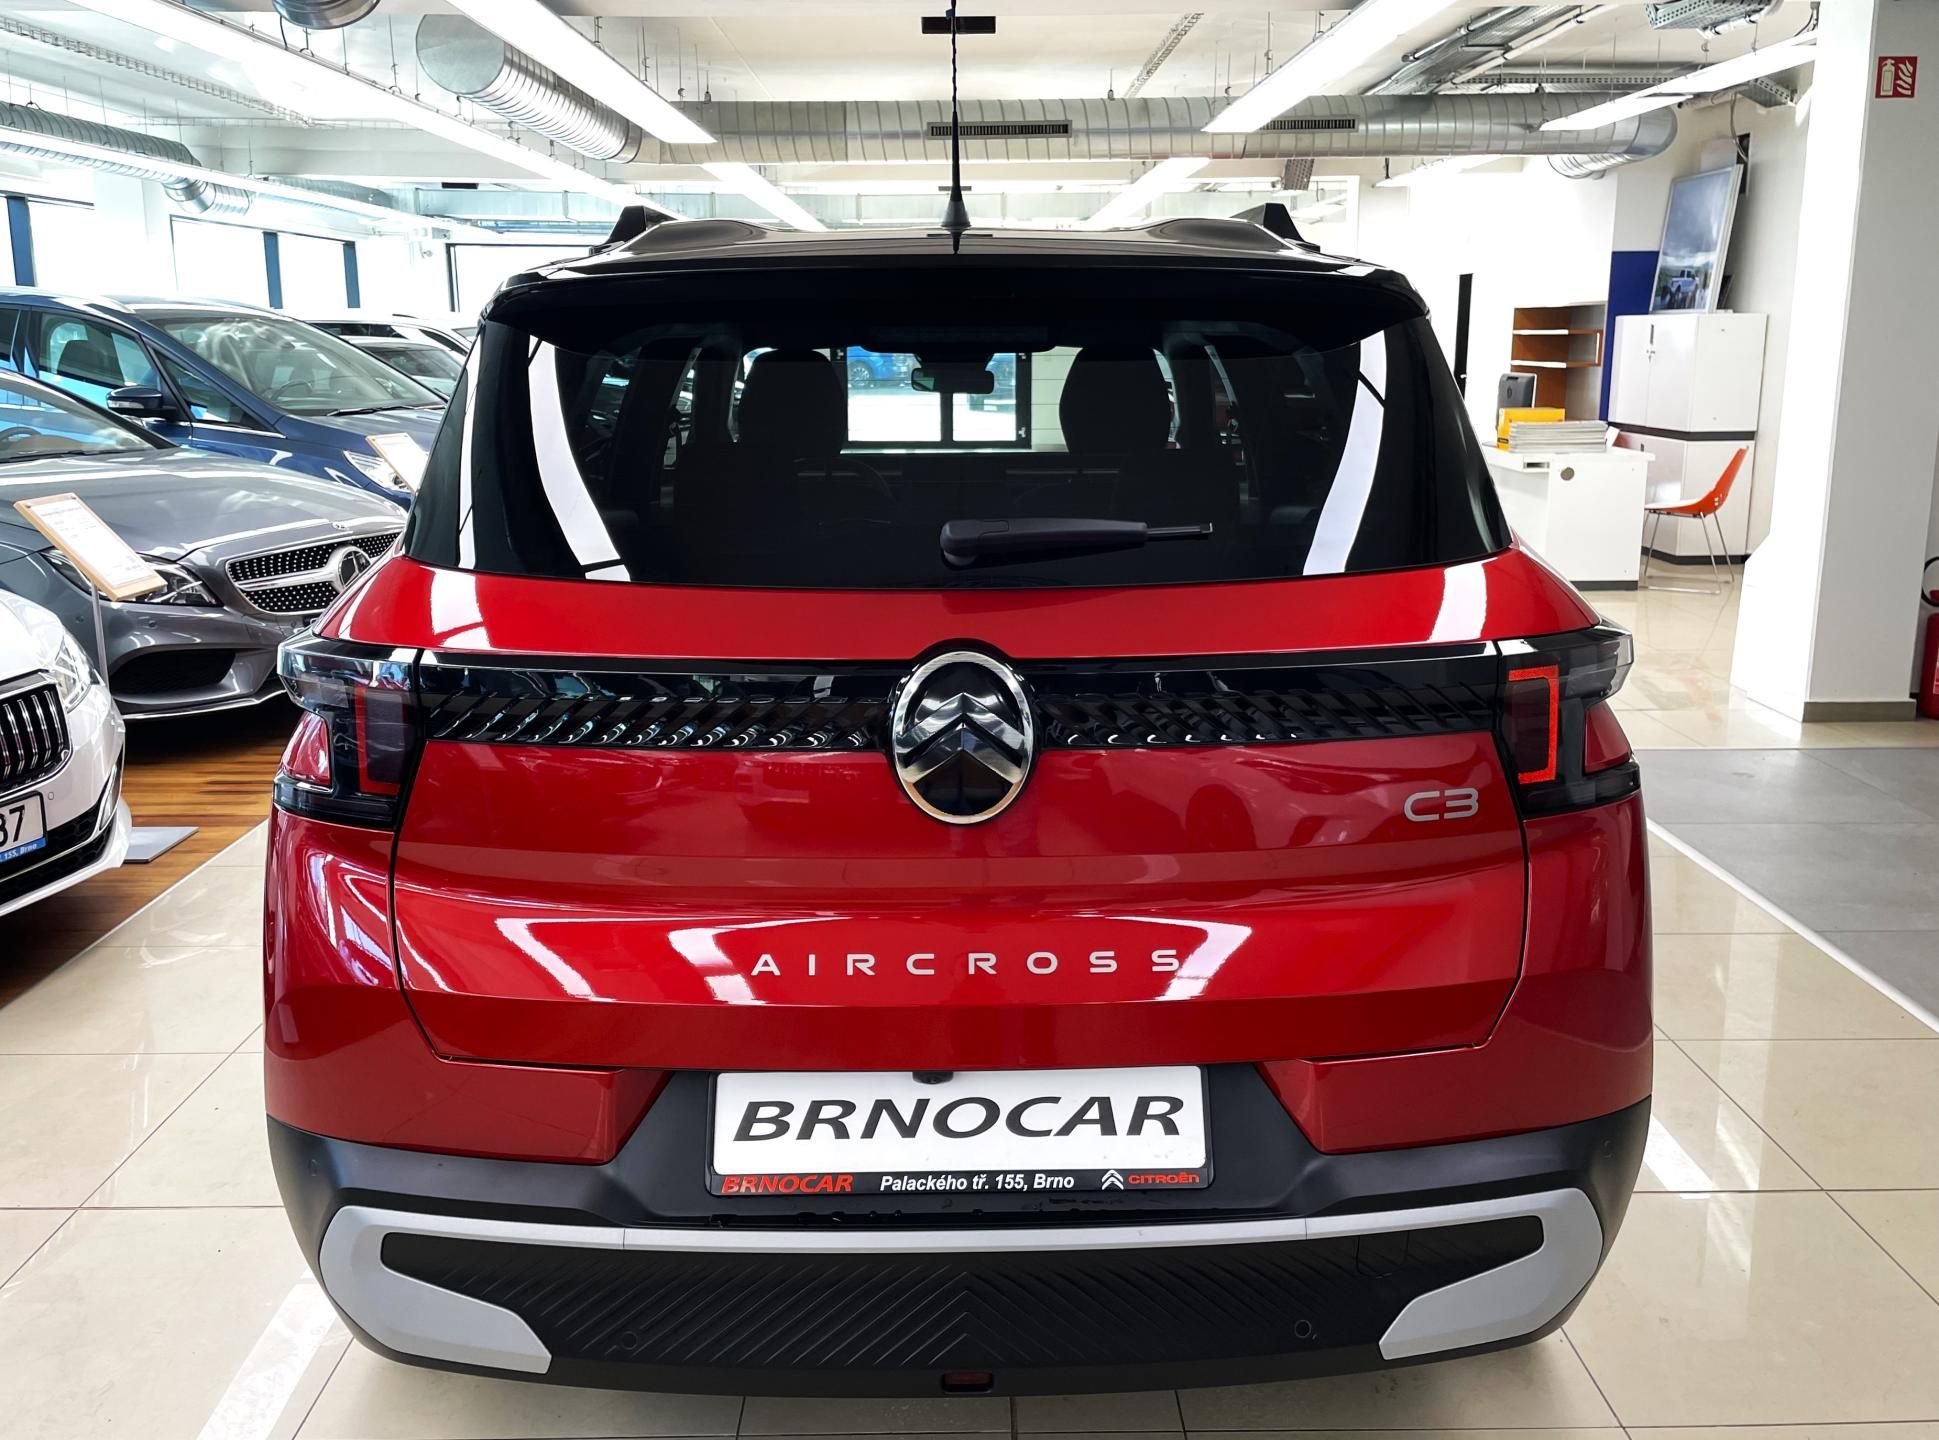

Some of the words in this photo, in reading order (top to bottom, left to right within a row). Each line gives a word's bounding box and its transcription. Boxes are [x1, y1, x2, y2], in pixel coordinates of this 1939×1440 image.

[1404, 787, 1479, 822] C3
[751, 950, 1180, 976] AIRCROSS
[732, 1096, 1185, 1142] BRNOCAR
[721, 1174, 853, 1193] BRNOCAR
[880, 1174, 968, 1191] Palackého
[972, 1173, 989, 1190] tř.
[996, 1173, 1028, 1192] 155,
[1033, 1173, 1075, 1189] Brno
